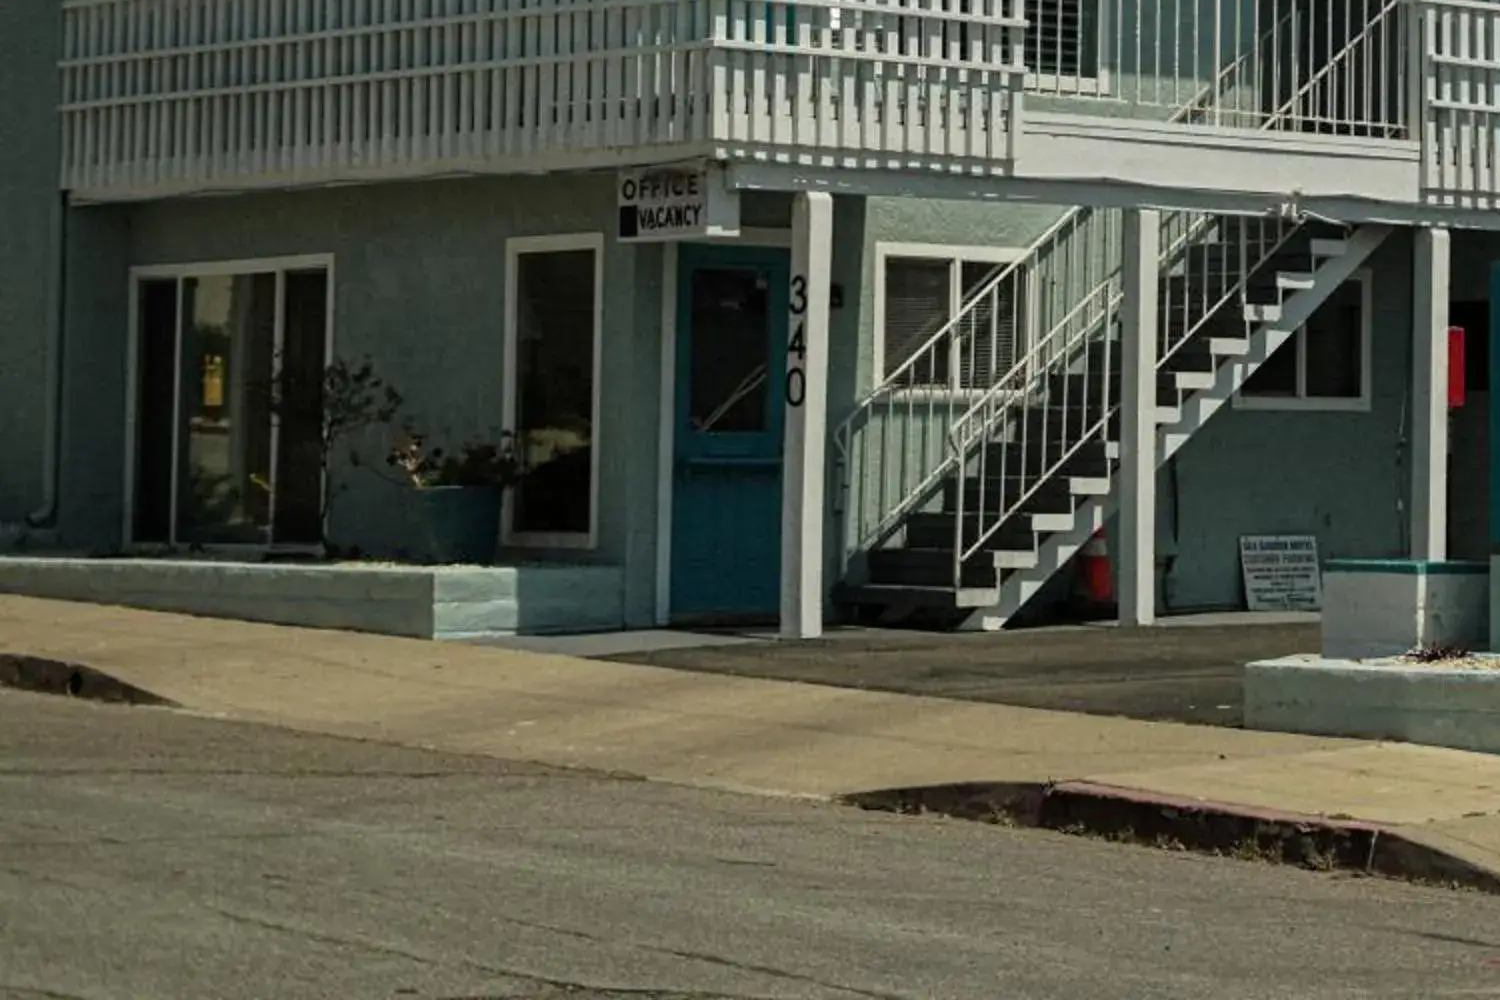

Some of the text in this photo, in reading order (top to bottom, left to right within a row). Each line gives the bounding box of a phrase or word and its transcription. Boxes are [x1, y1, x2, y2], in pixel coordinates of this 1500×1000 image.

[622, 173, 699, 200] OFFICE
[638, 203, 702, 230] VACANCY
[786, 275, 807, 407] 340
